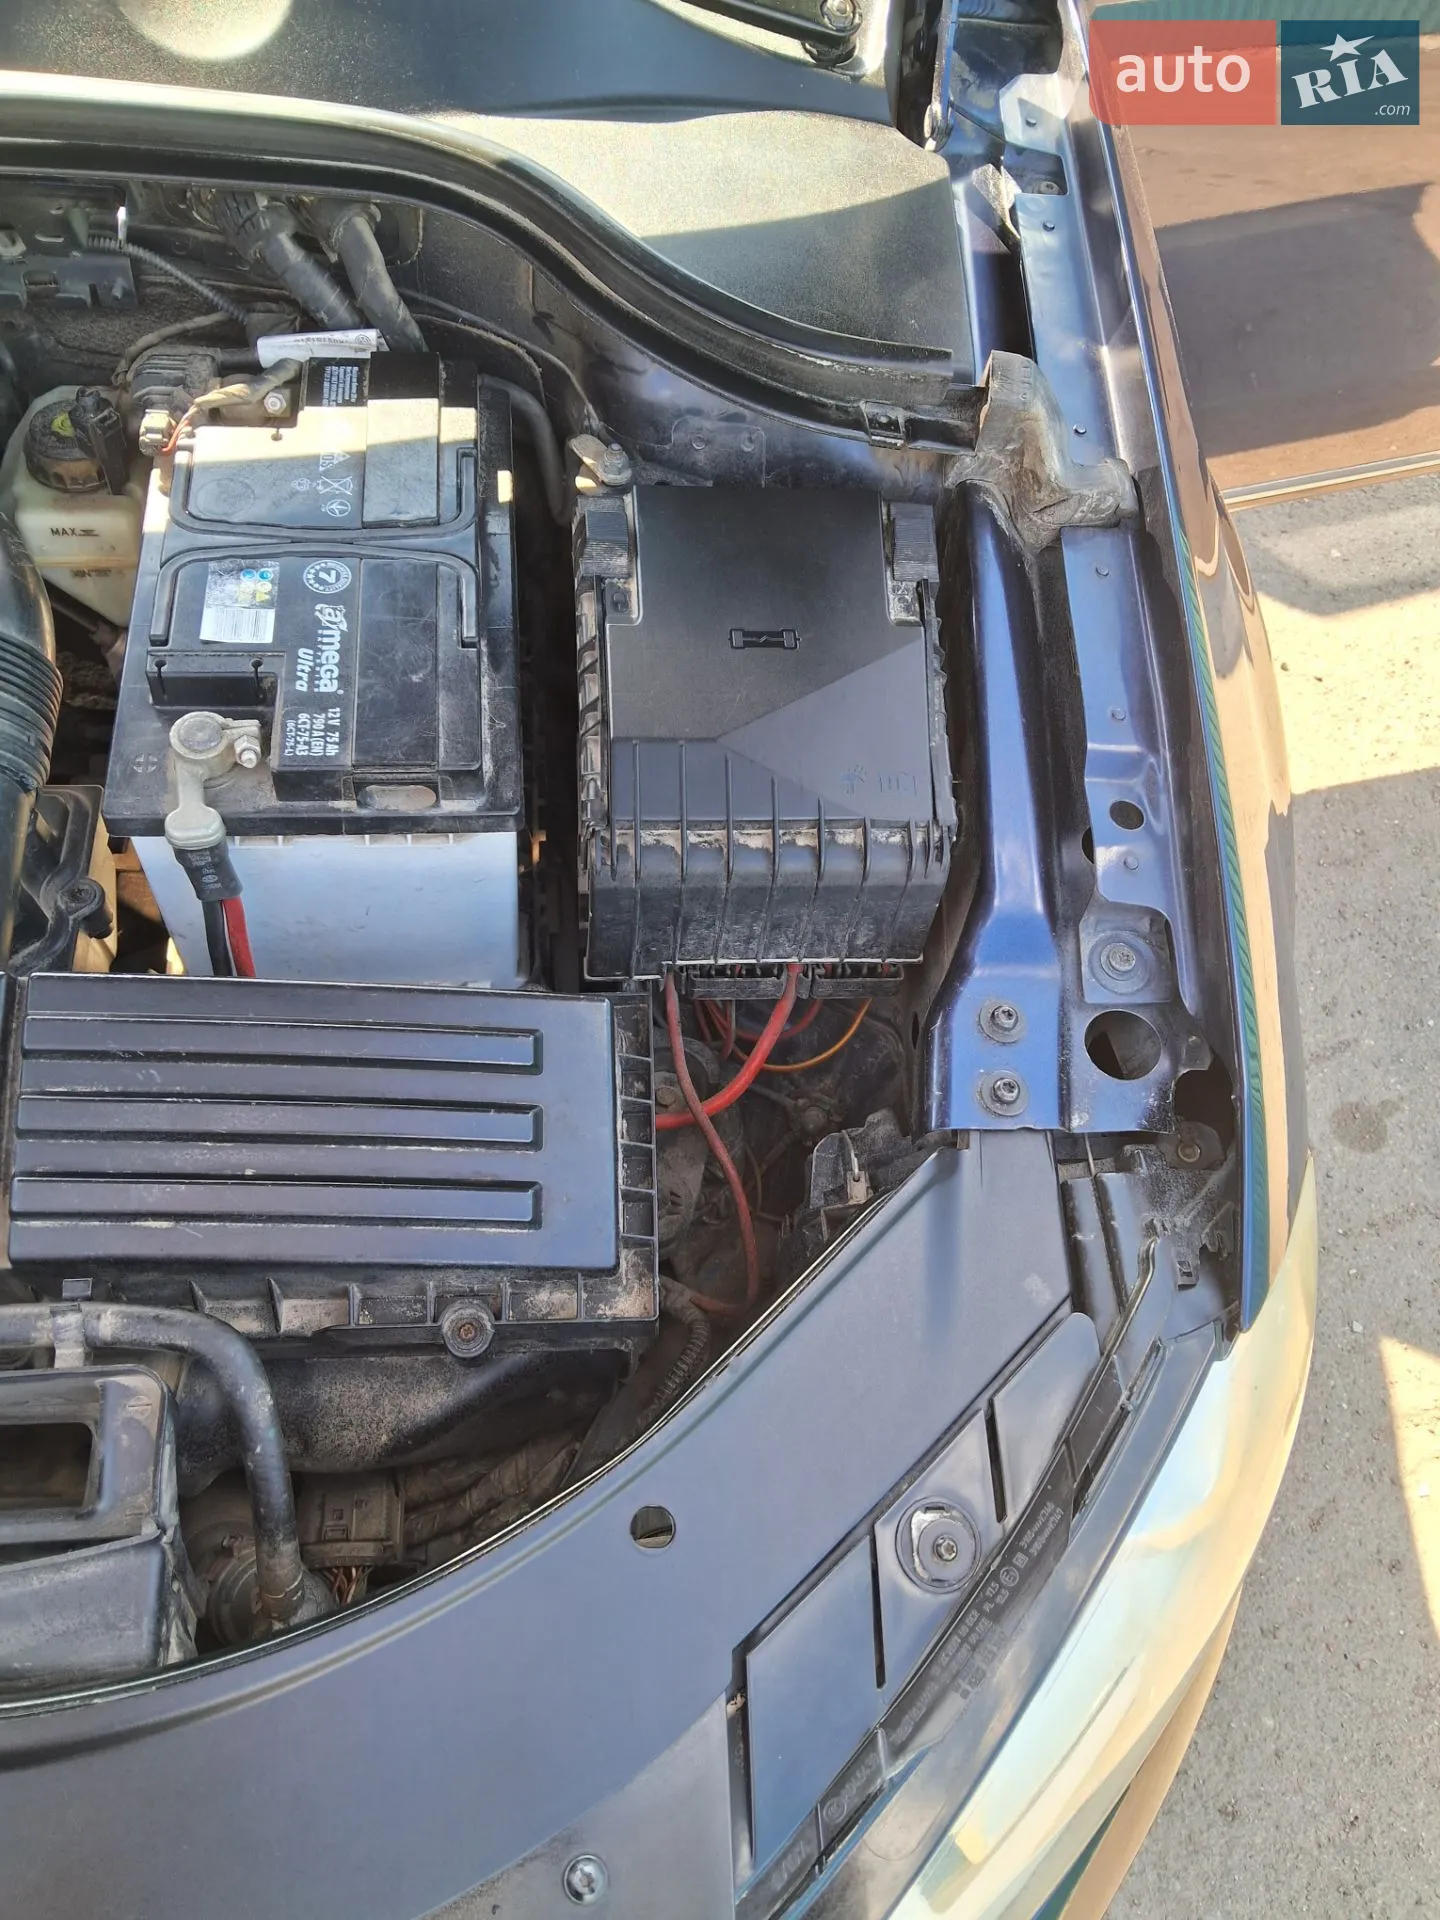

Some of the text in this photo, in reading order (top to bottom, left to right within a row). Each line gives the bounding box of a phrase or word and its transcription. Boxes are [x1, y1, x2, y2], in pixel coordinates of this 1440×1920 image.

[50, 527, 78, 537] MAX
[319, 570, 336, 584] 7
[295, 647, 314, 692] Ultra
[295, 712, 311, 757] 6CT-75-A3
